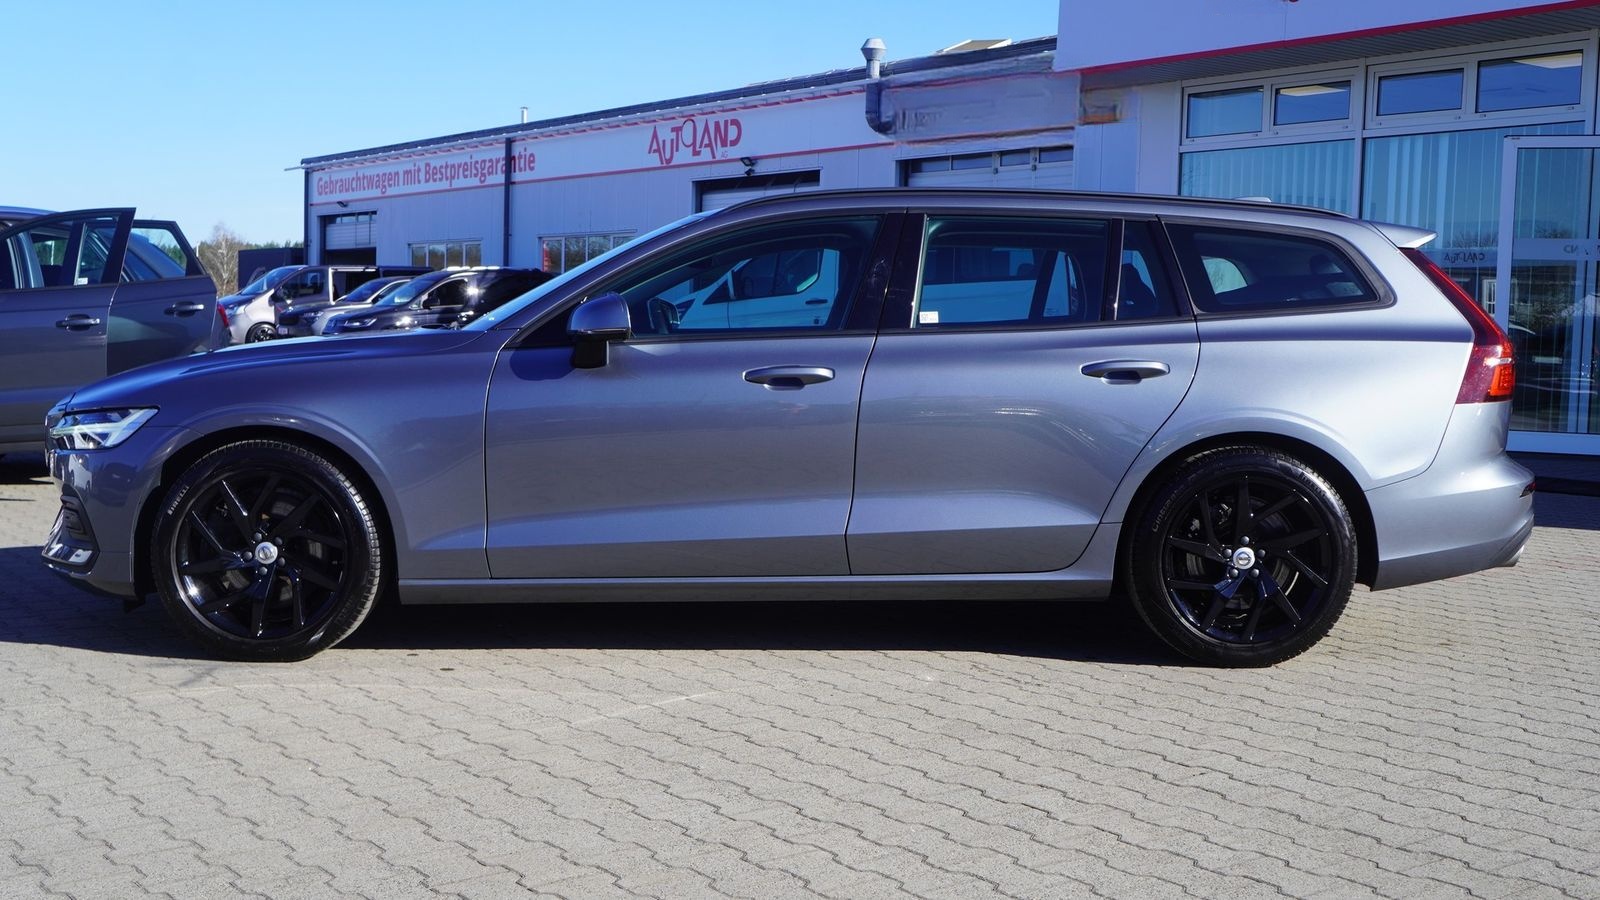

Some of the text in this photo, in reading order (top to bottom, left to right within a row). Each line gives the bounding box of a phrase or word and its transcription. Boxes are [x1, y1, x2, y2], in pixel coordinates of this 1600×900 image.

[648, 118, 742, 165] AUTOLAND
[317, 148, 536, 196] Gebrauchtwagen mit Bestpreisgarantie
